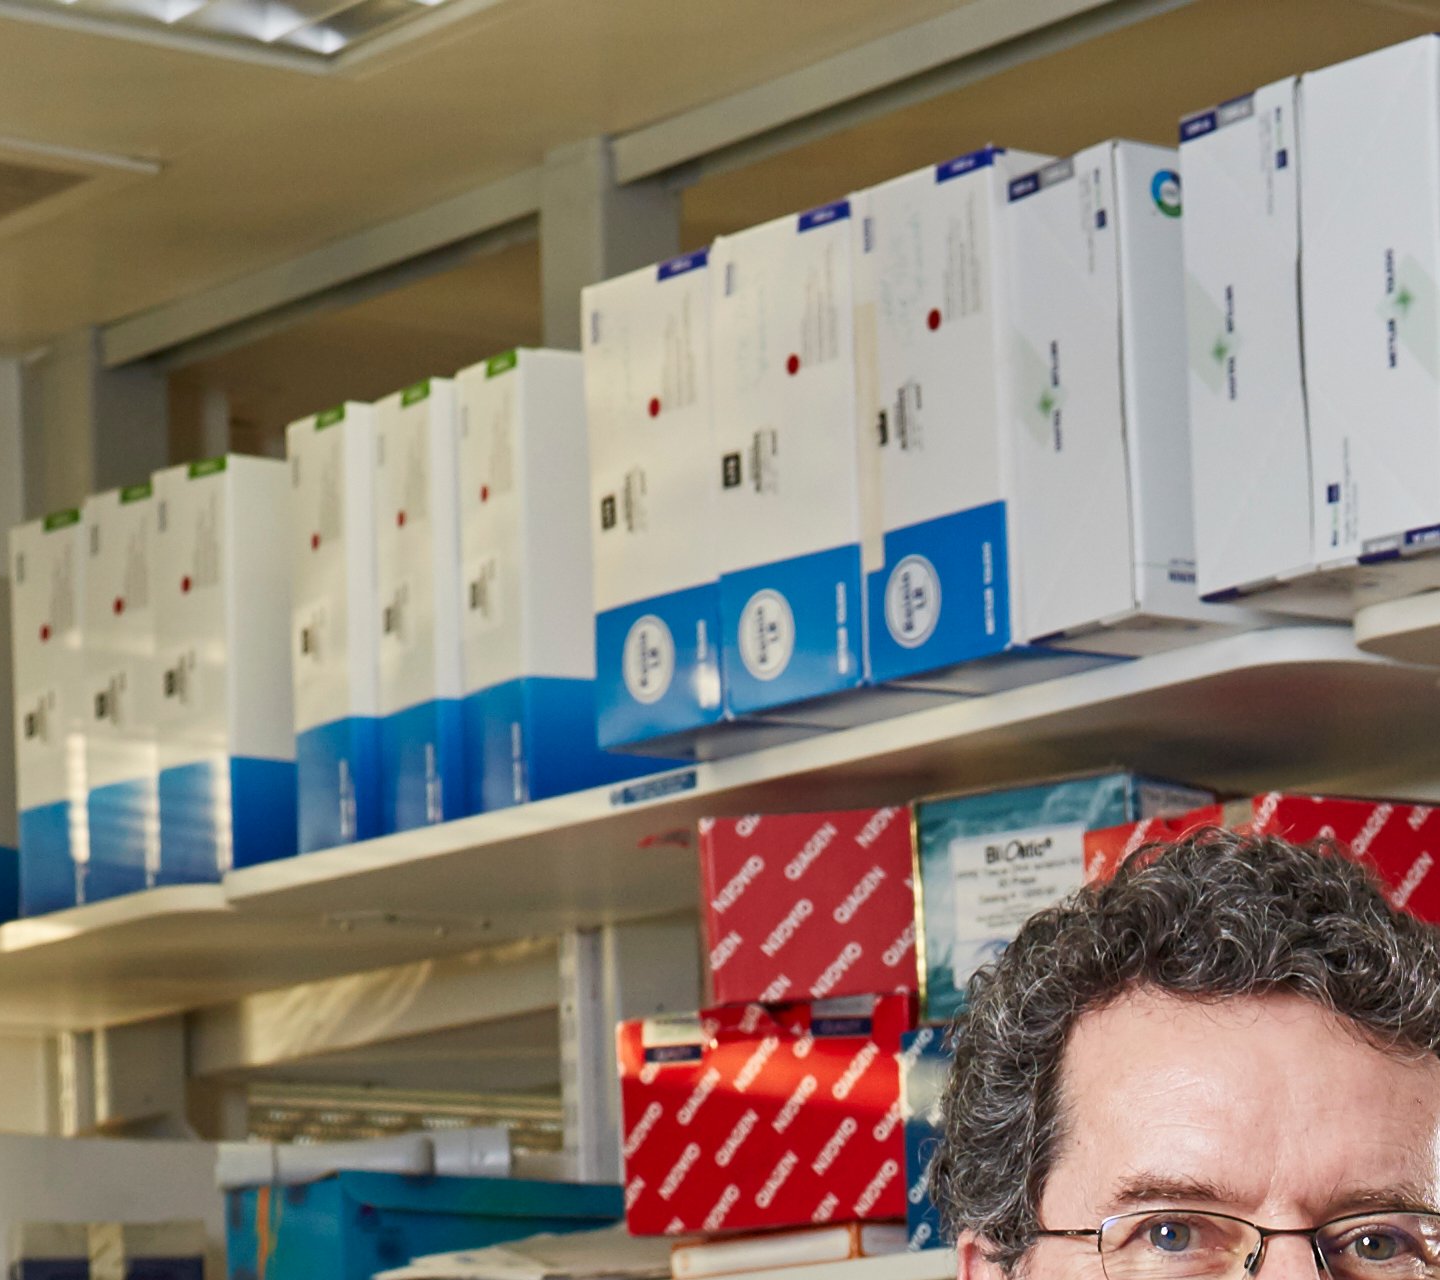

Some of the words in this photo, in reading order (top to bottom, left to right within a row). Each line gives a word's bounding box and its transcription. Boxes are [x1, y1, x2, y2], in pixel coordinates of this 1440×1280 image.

[784, 821, 838, 881] QIAGEN
[711, 854, 765, 914] QIAGEN
[832, 865, 887, 924] QIAGEN
[760, 898, 814, 958] QIAGEN
